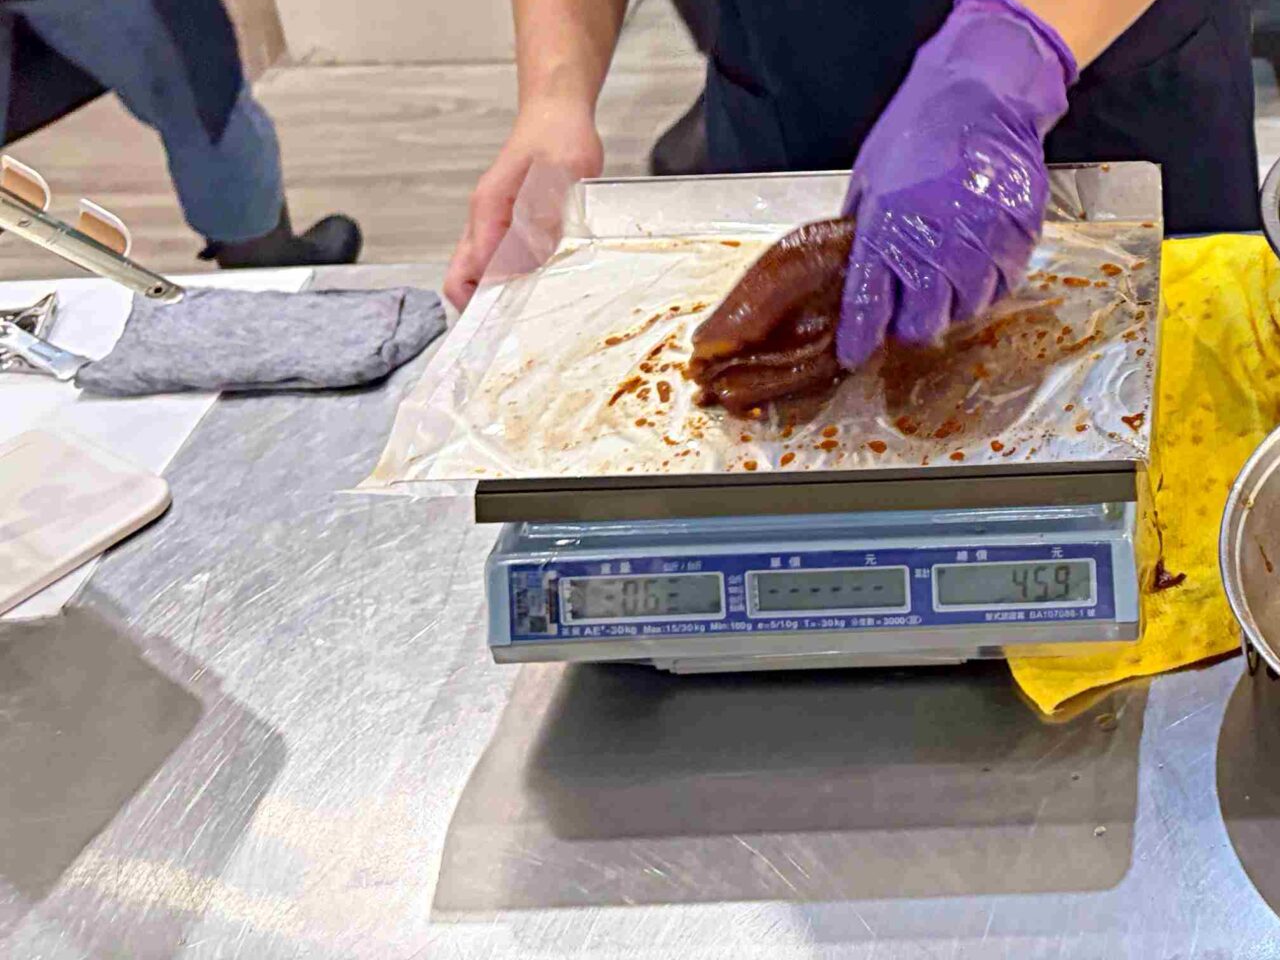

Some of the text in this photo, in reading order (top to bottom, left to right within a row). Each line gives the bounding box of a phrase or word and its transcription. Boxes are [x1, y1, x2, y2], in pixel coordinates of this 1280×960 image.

[1051, 546, 1064, 558] 元
[864, 553, 878, 565] 元
[1012, 565, 1071, 601] 459
